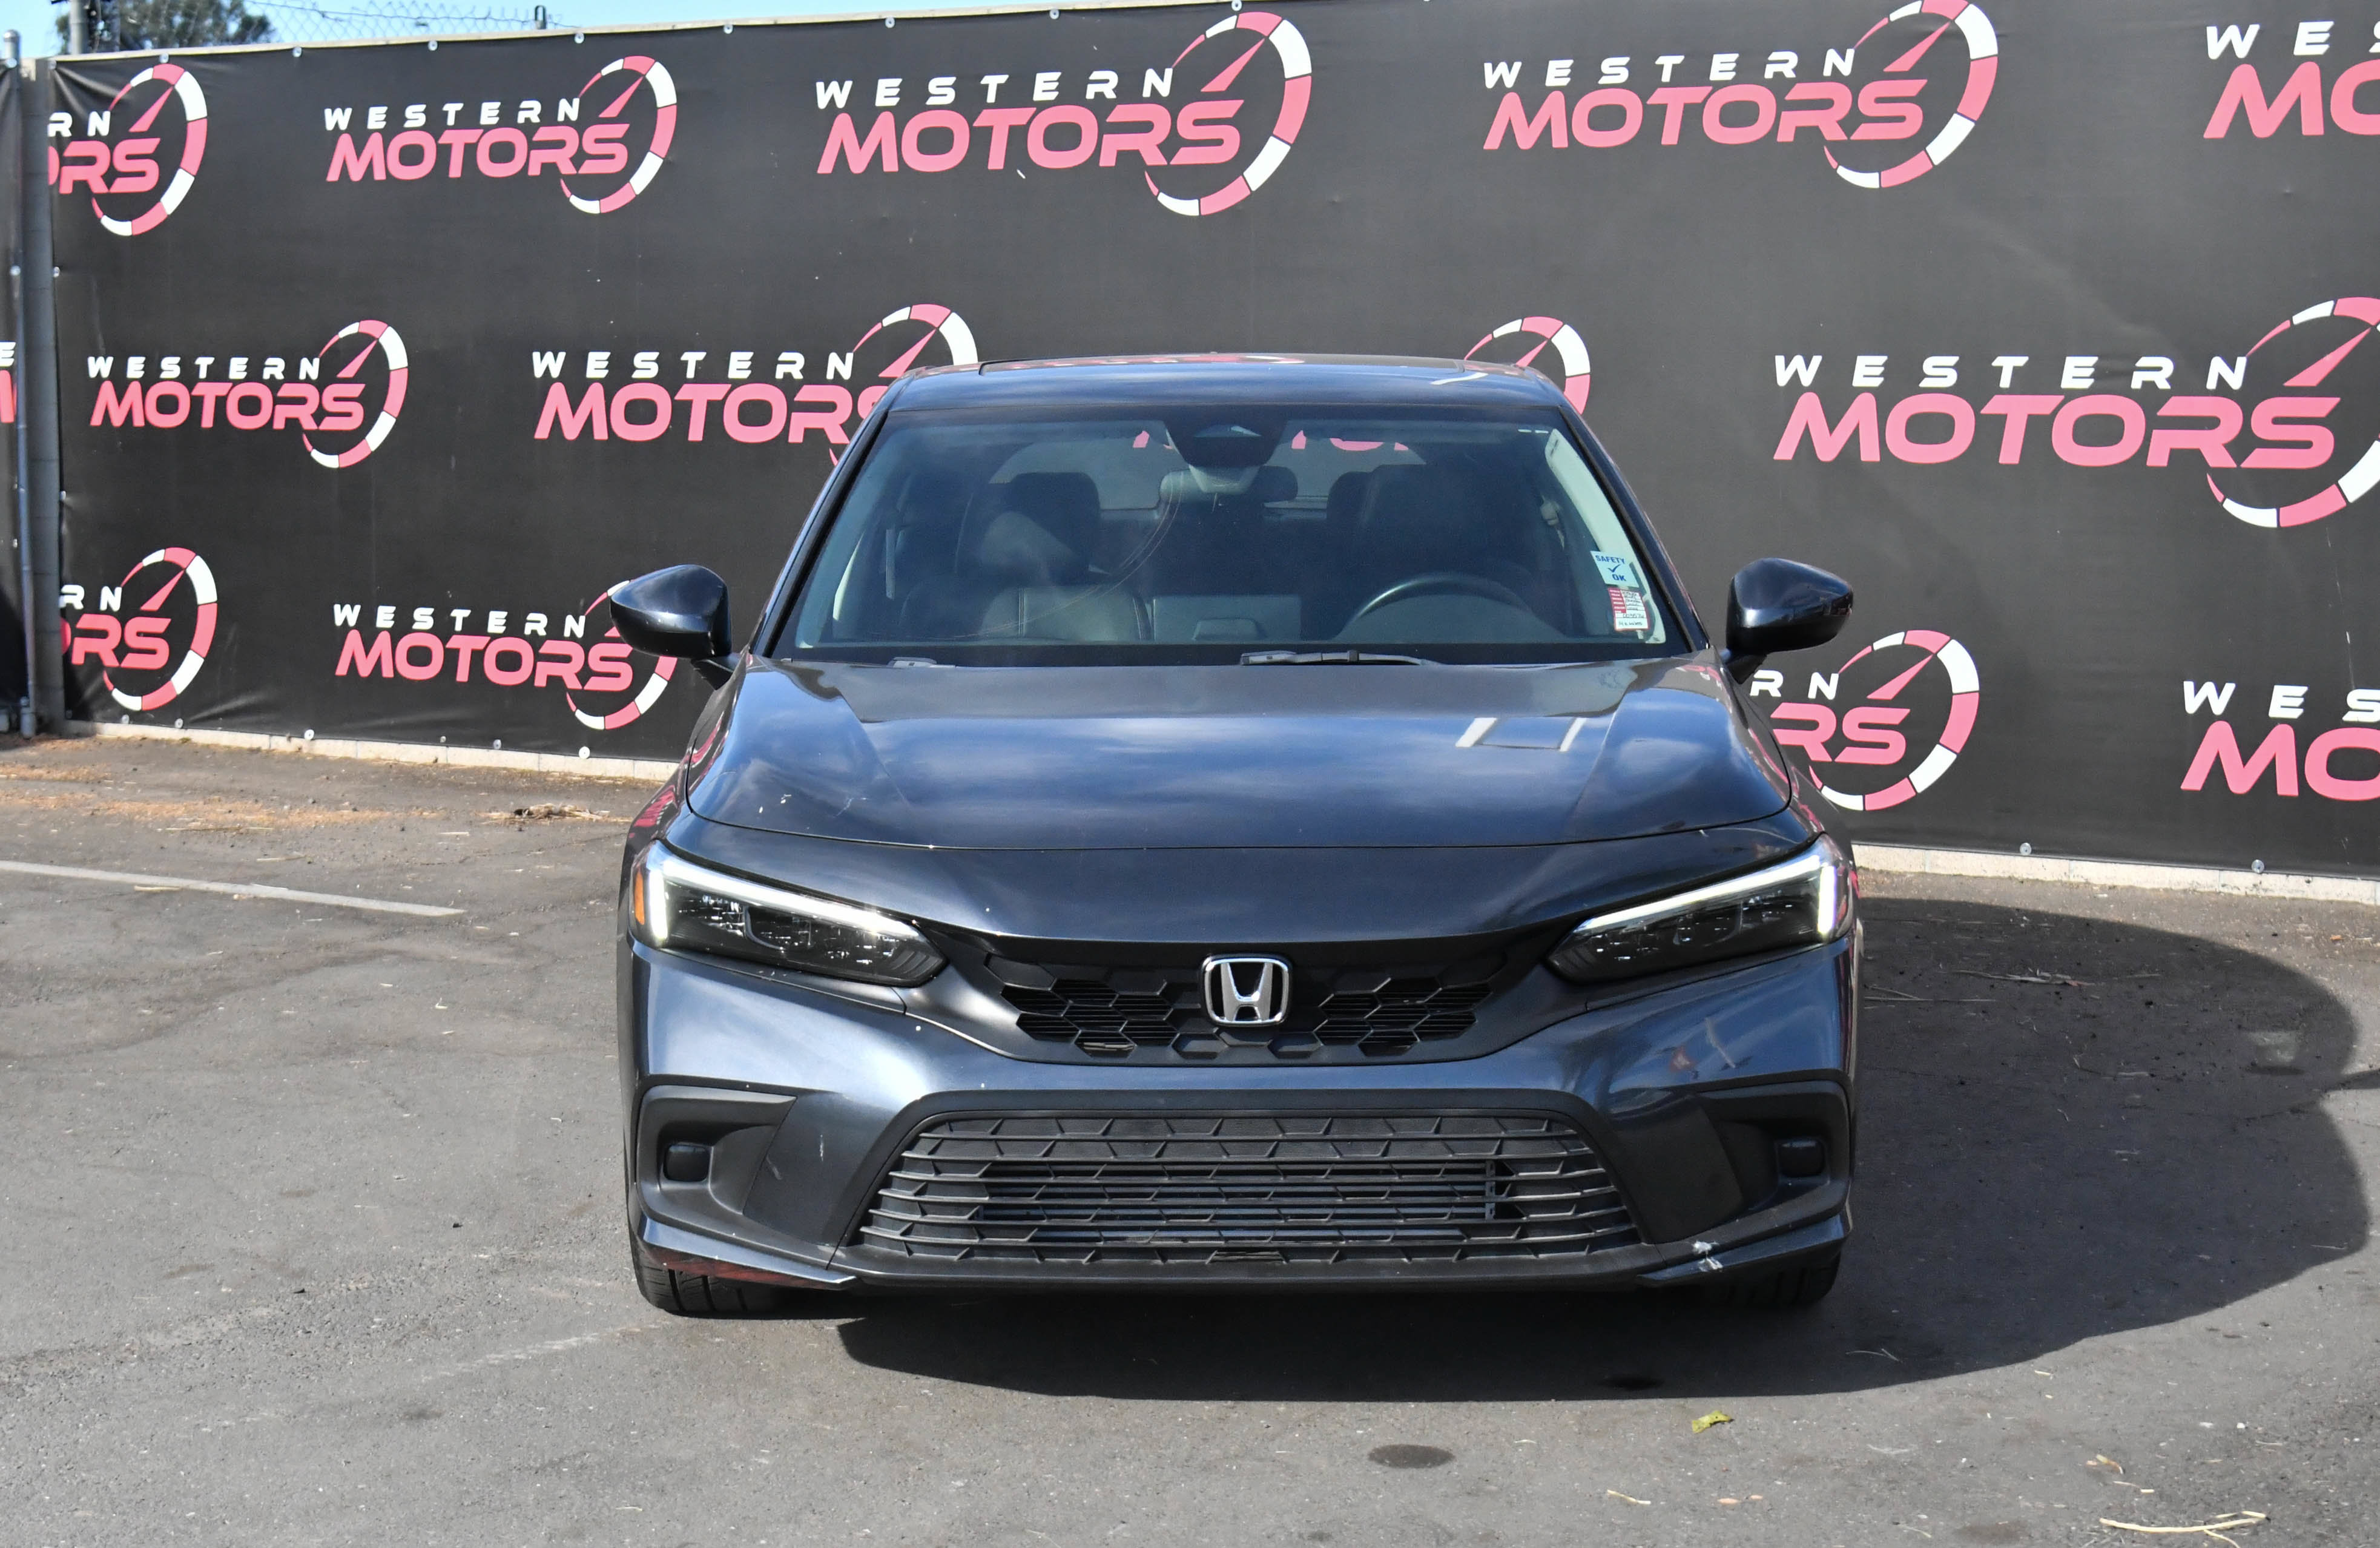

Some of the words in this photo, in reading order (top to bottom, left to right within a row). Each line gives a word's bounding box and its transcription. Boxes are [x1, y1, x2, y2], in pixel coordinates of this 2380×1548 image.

[816, 68, 1173, 109] WESTERN
[1484, 48, 1855, 89] WESTERN
[47, 111, 110, 137] RN
[325, 98, 579, 131] WESTERN
[1484, 79, 1928, 150] MOTORS
[326, 124, 630, 182] MOTORS
[817, 99, 1244, 174] MOTORS
[48, 138, 160, 194] RS
[88, 357, 320, 380] WESTERN
[533, 351, 854, 380] WESTERN
[1775, 355, 2247, 390] WESTERN
[90, 381, 365, 430] MOTORS
[534, 382, 888, 444] MOTOR
[1774, 392, 2341, 469] MOTORS
[1595, 555, 1626, 564] SAFETY
[1612, 573, 1627, 582] OK
[59, 585, 122, 611] RN
[334, 604, 585, 638] WESTERN
[60, 614, 171, 670] RS
[335, 630, 633, 691] MOTORS
[1750, 670, 1839, 700] RN
[2184, 681, 2380, 722] WES
[2181, 720, 2380, 801] MO
